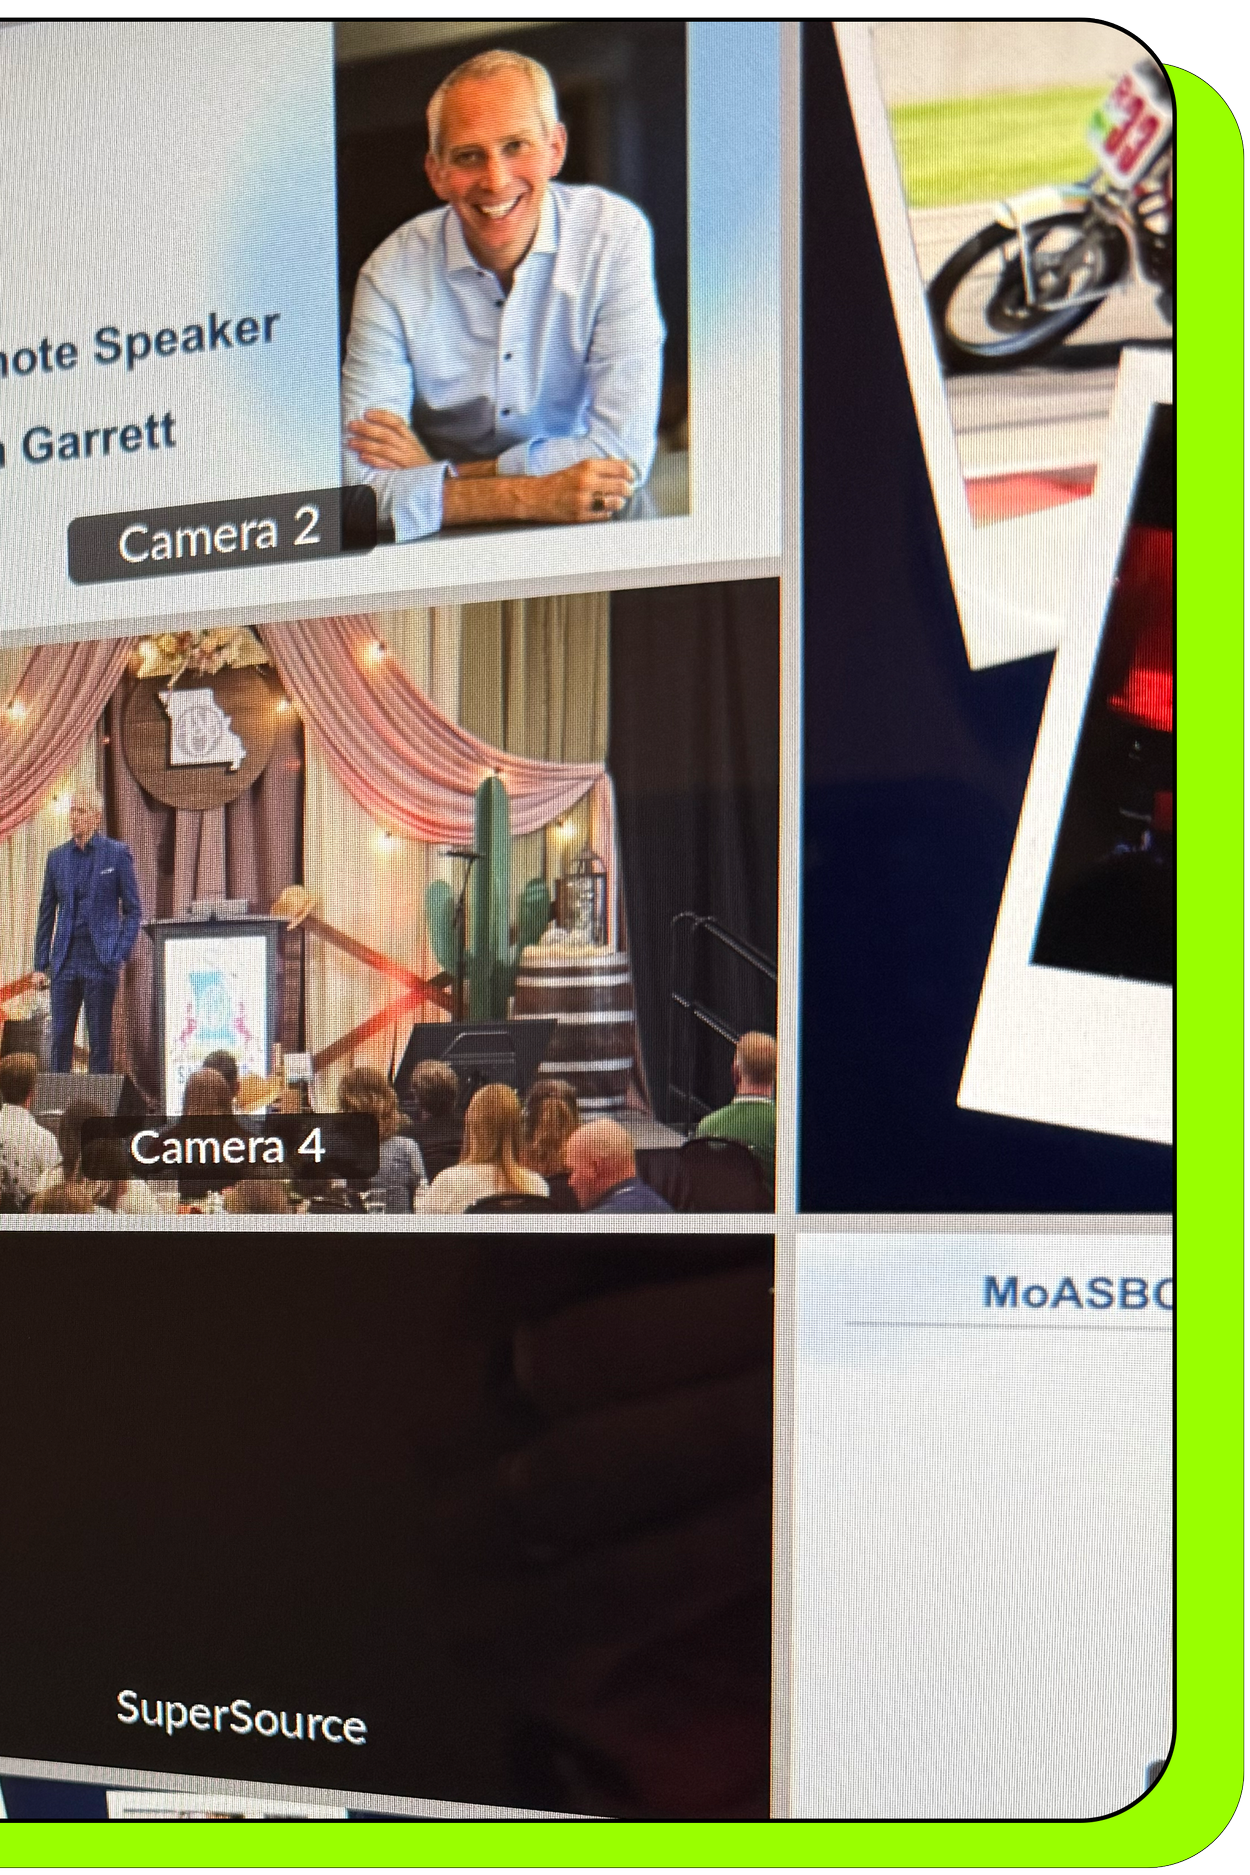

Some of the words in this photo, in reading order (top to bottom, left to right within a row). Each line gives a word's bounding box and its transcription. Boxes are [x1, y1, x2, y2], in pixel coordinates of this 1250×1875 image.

[92, 312, 281, 372] Speaker
[21, 411, 177, 465] Garrett
[117, 517, 278, 564] Camera
[292, 505, 321, 545] 2
[130, 1130, 285, 1165] Camera
[297, 1127, 326, 1163] 4
[117, 1689, 367, 1746] SuperSource
